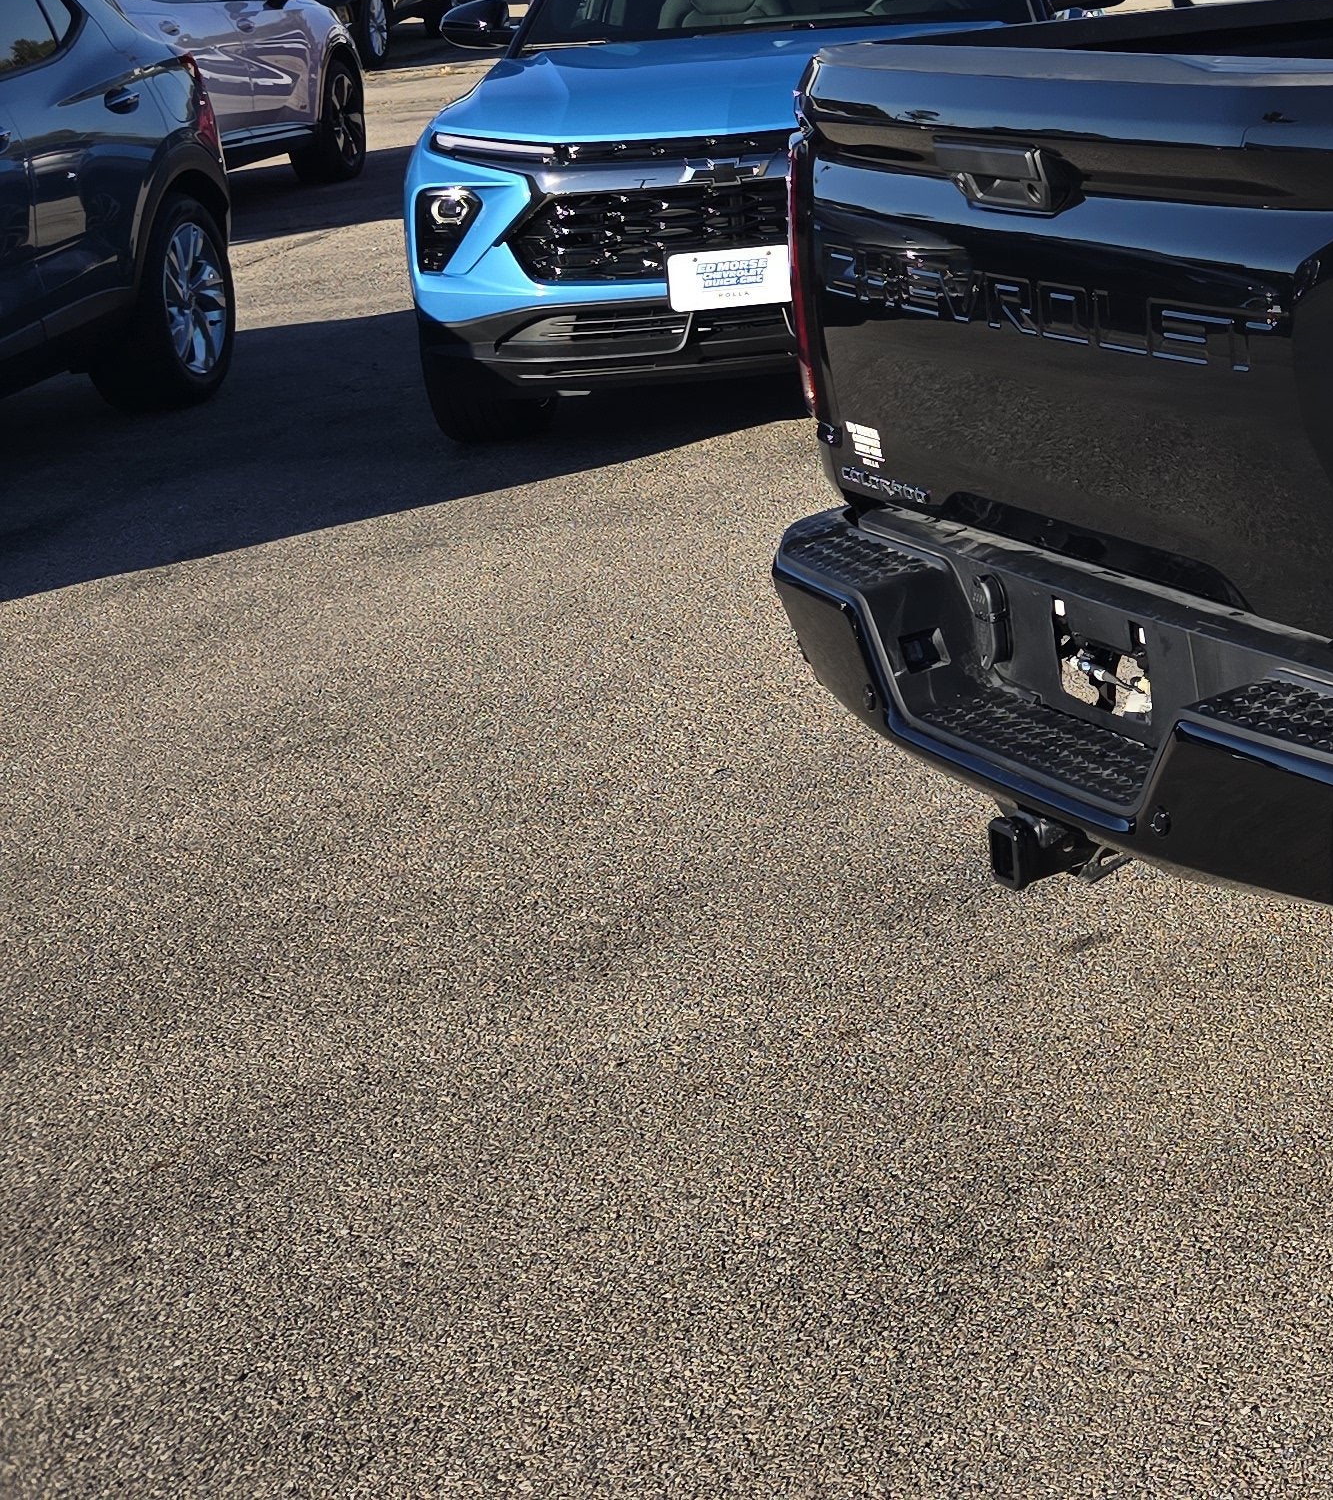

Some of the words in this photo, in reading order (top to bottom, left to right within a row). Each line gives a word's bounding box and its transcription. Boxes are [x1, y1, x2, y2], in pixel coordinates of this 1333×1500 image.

[696, 262, 717, 275] ED
[716, 257, 768, 272] MORSE
[823, 243, 1289, 372] CHEVROLET
[841, 466, 927, 505] COLORADO
